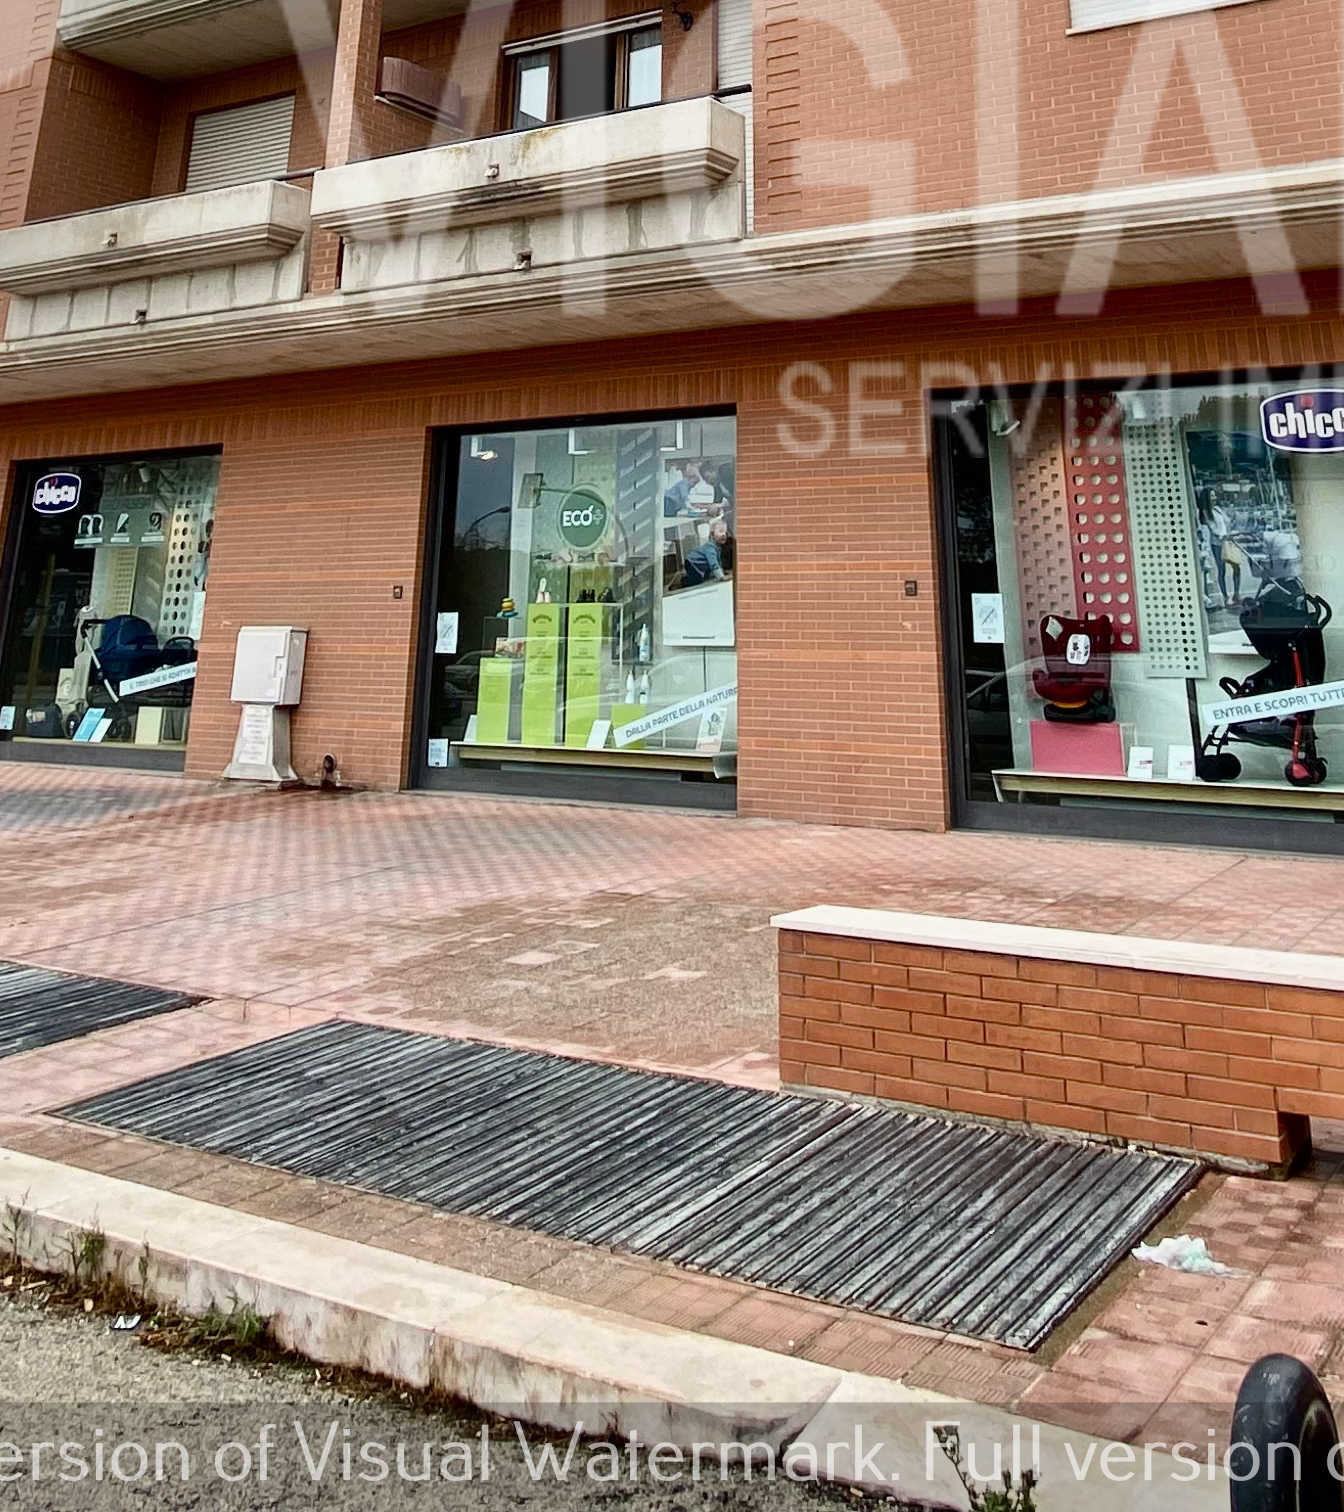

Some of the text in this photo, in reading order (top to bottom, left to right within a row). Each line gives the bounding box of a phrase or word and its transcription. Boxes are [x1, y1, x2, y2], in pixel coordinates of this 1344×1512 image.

[625, 723, 652, 738] DALLA
[652, 709, 678, 726] PARTE
[679, 700, 705, 717] DELLA
[1213, 705, 1252, 720] ENTRA
[1254, 703, 1263, 713] E
[1265, 695, 1309, 712] SCOPRI
